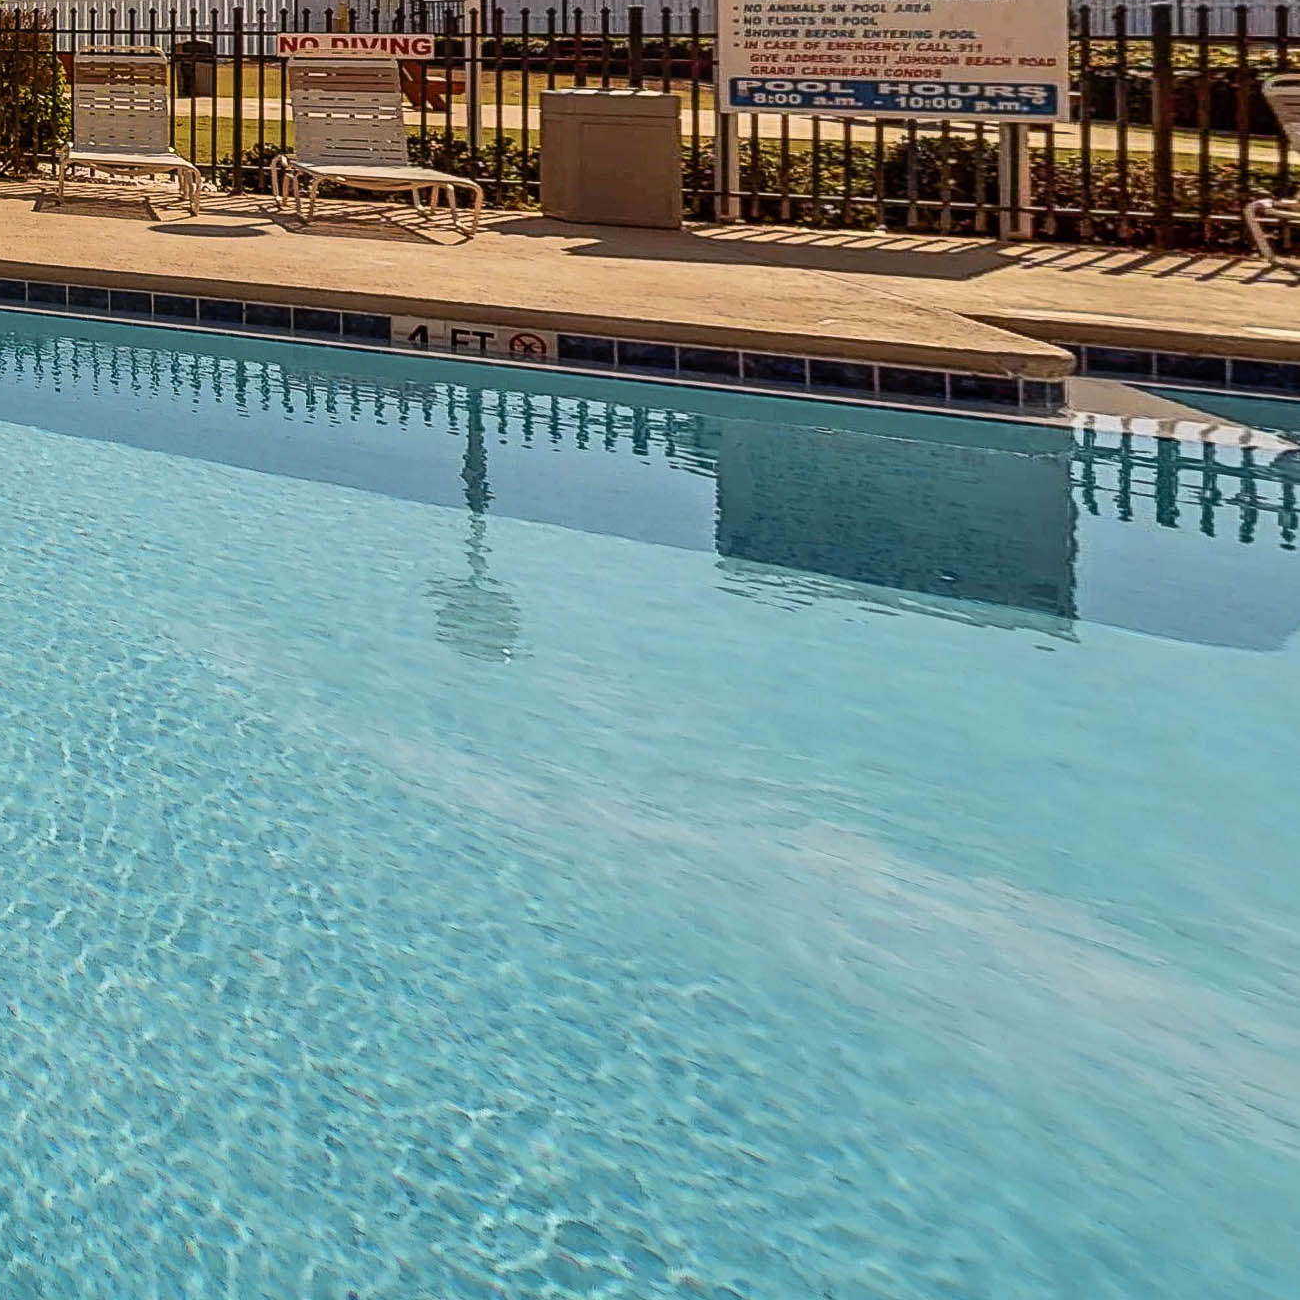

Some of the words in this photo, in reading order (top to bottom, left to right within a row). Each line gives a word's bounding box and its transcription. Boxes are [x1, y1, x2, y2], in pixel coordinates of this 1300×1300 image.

[743, 4, 762, 13] NO
[768, 4, 826, 13] ANIMALS
[832, 4, 846, 13] IN
[852, 4, 887, 13] POOL
[894, 3, 931, 12] AREA
[743, 16, 762, 25] NO
[768, 16, 816, 25] FLOATS
[821, 17, 836, 25] IN
[842, 16, 878, 26] POOL
[743, 29, 799, 38] SHOWER
[804, 29, 856, 38] BEFORE
[862, 29, 933, 39] ENTERING
[939, 30, 976, 39] POOL
[279, 37, 320, 53] NO
[331, 37, 432, 55] DIVING
[744, 41, 759, 50] IN
[764, 41, 798, 50] CASE
[803, 41, 819, 50] OF
[827, 41, 911, 51] EMERGENCY
[916, 42, 951, 52] CALL
[750, 53, 779, 63] GIVE
[894, 55, 960, 65] JOHNSON
[965, 56, 1012, 66] BEACH
[1018, 57, 1057, 67] ROAD
[751, 66, 795, 75] GRAND
[884, 68, 942, 78] CONDOS
[736, 80, 855, 94] POOL
[878, 83, 1048, 98] HOURS
[753, 93, 802, 104] 8:00
[812, 96, 863, 106] a.m.
[895, 97, 963, 109] 10:00
[974, 101, 1030, 112] p.m.
[451, 328, 495, 354] FT
